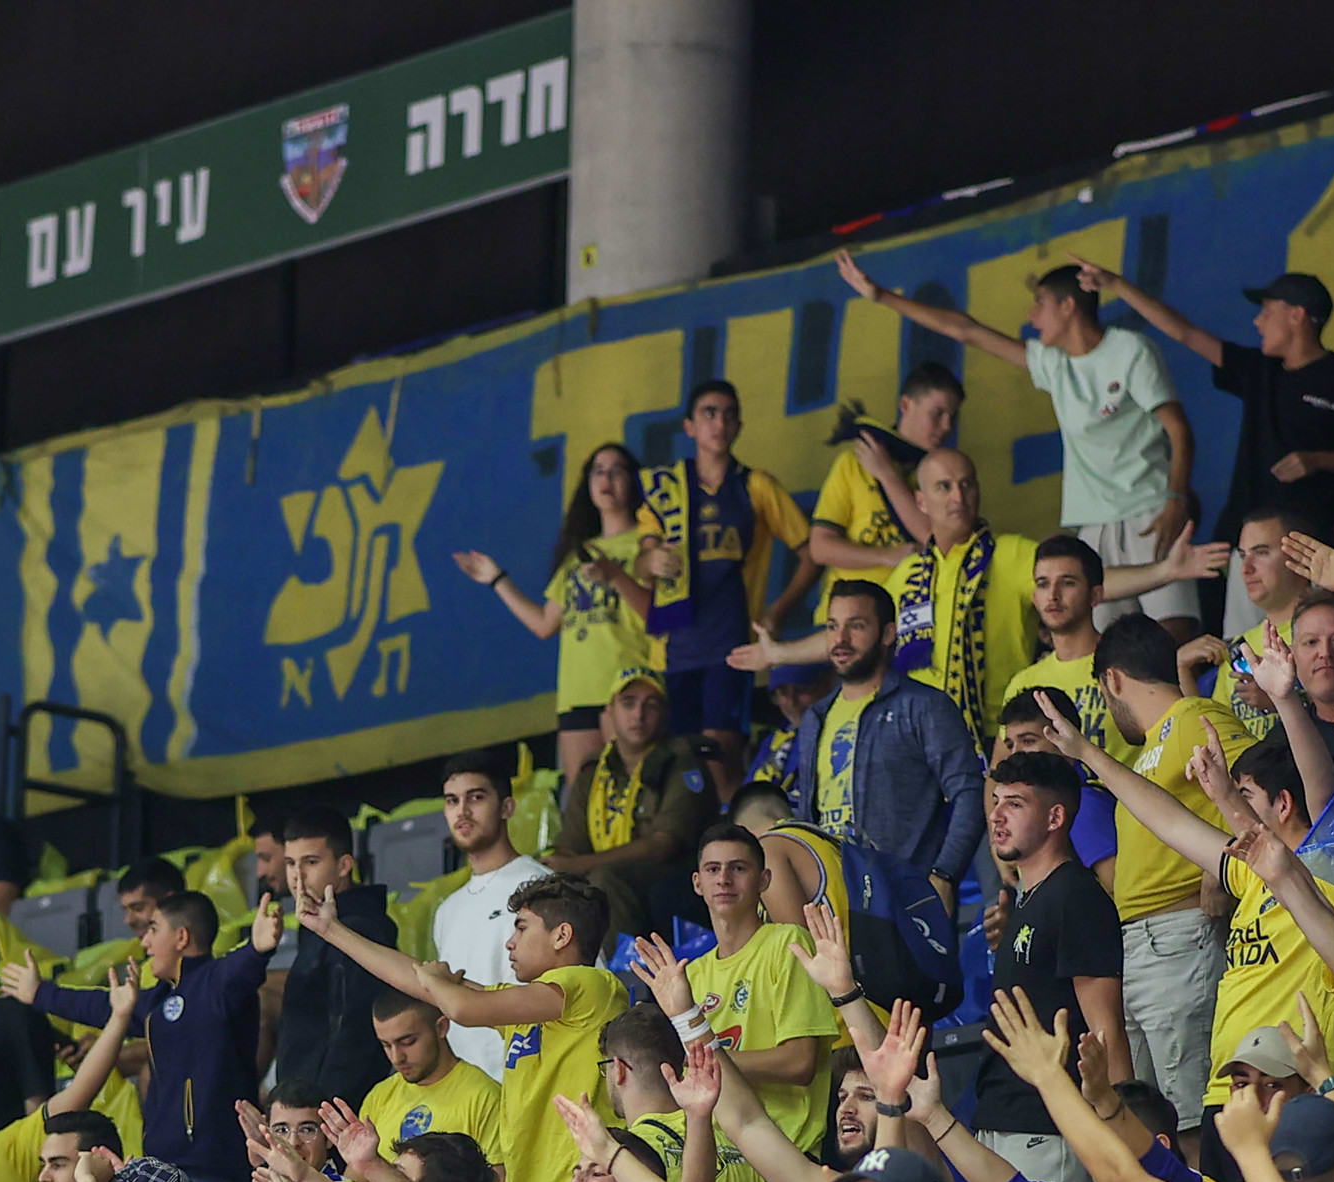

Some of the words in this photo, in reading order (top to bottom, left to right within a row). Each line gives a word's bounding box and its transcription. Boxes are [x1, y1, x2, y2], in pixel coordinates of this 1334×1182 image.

[405, 57, 569, 175] חדרה
[26, 203, 97, 289] עם
[122, 168, 210, 258] עיר
